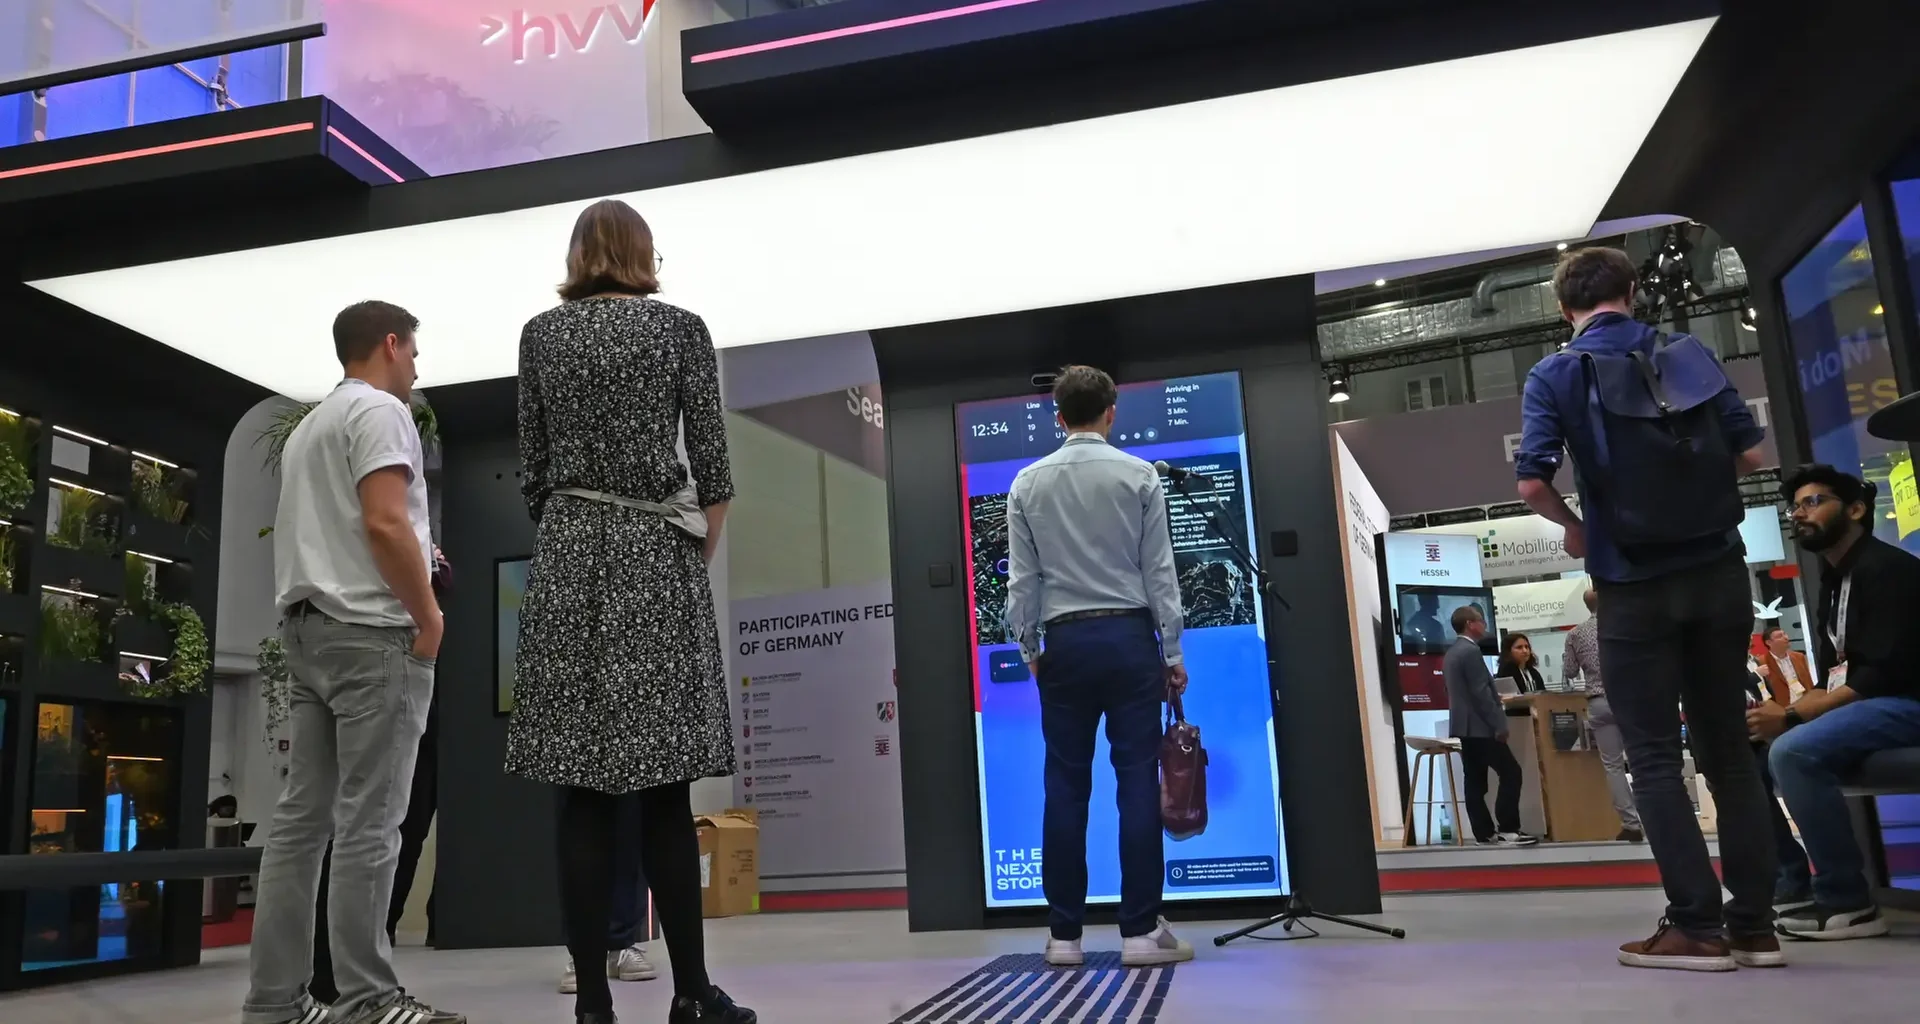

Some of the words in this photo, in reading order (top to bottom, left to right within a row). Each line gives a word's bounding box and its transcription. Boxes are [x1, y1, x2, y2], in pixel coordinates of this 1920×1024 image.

[1165, 385, 1192, 393] Arriving
[1166, 397, 1172, 405] 2
[971, 421, 1009, 437] 12:34
[1028, 423, 1036, 431] 19
[1420, 569, 1450, 577] HESSEN
[1500, 600, 1565, 616] Mobilligence
[739, 607, 860, 635] PARTICIPATING
[739, 640, 760, 656] OF
[764, 630, 845, 653] GERMANY
[995, 848, 1042, 861] THE
[996, 862, 1042, 876] NEXT
[997, 877, 1043, 890] STOP
